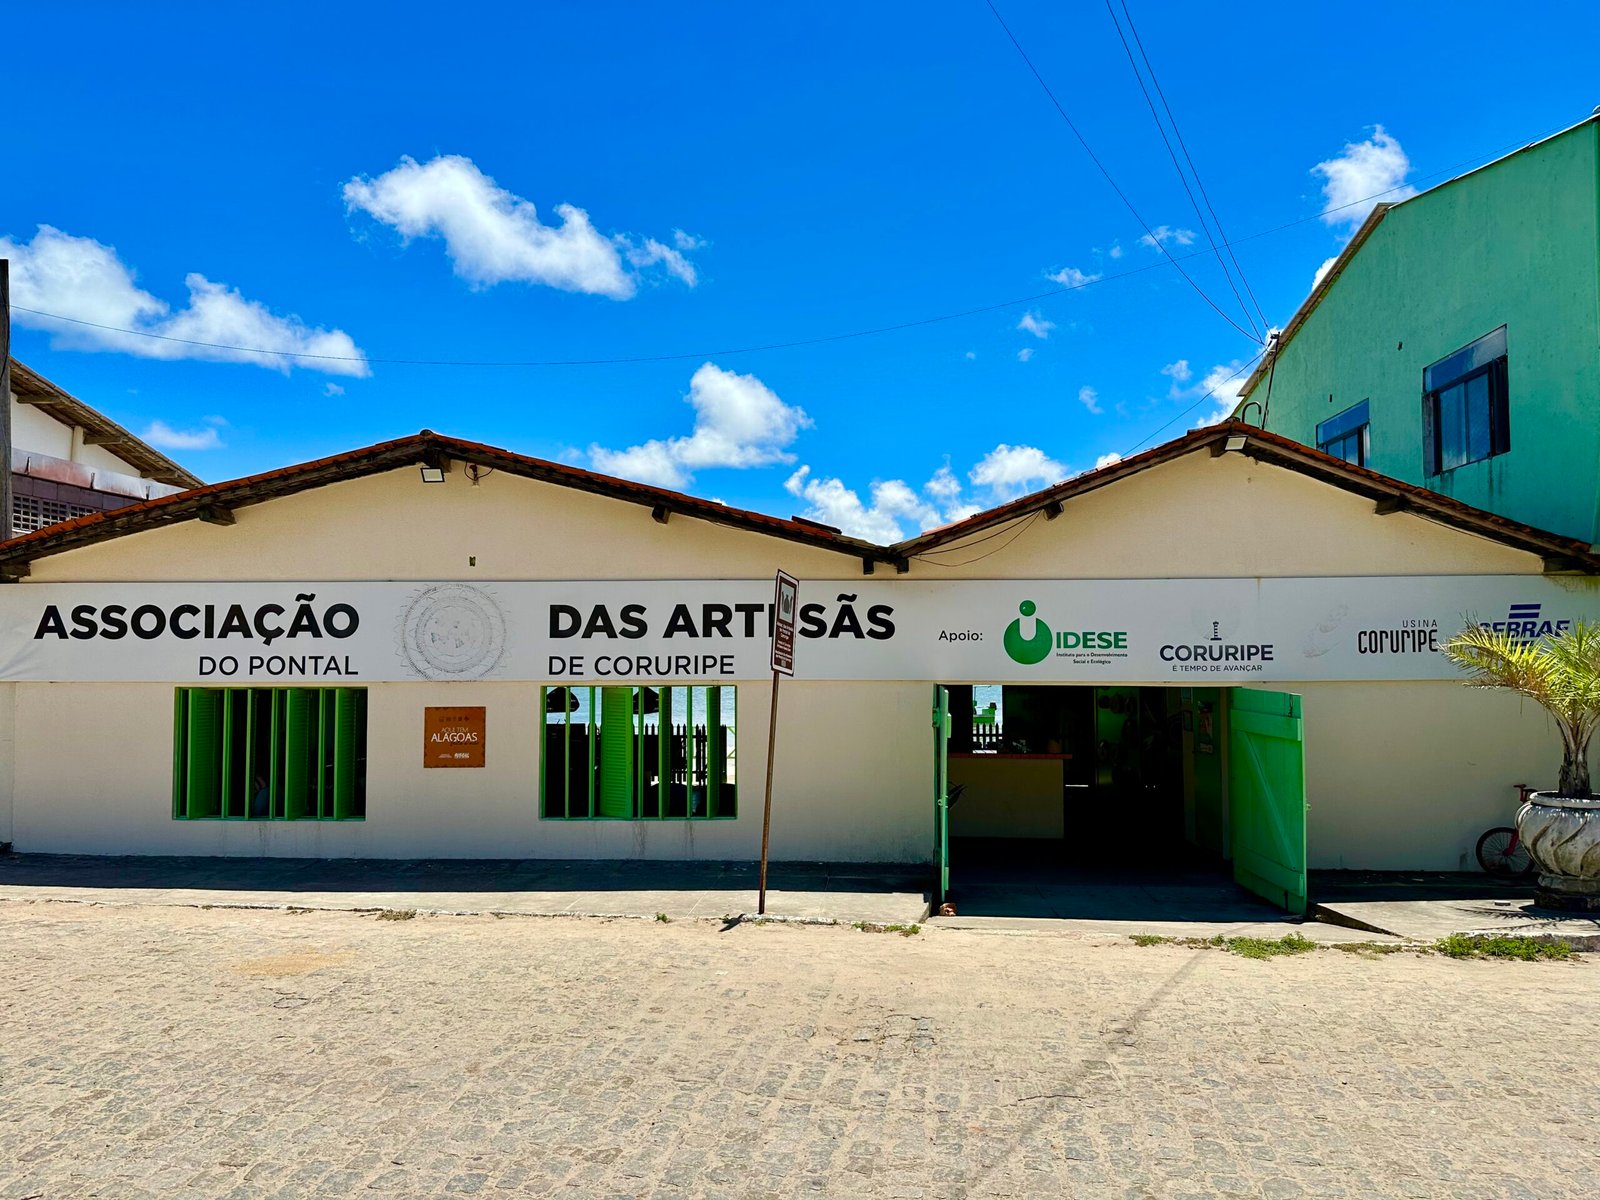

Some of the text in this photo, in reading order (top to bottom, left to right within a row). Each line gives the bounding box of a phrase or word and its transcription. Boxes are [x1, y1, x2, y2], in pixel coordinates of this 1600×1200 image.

[34, 593, 360, 646] ASSOCIAÇÃO
[549, 593, 896, 641] DAS ARTSÃS
[1402, 618, 1438, 628] USINA
[938, 629, 983, 643] Apoio:
[1056, 631, 1128, 650] IDESE
[1159, 644, 1275, 661] CORURIPE
[198, 655, 359, 676] DO PONTAL
[548, 654, 735, 676] DE CORURIPE
[1179, 664, 1209, 672] TEMPO
[1210, 664, 1222, 672] DE
[1223, 664, 1263, 673] AVANÇAR
[430, 732, 478, 742] ALAGOAS
